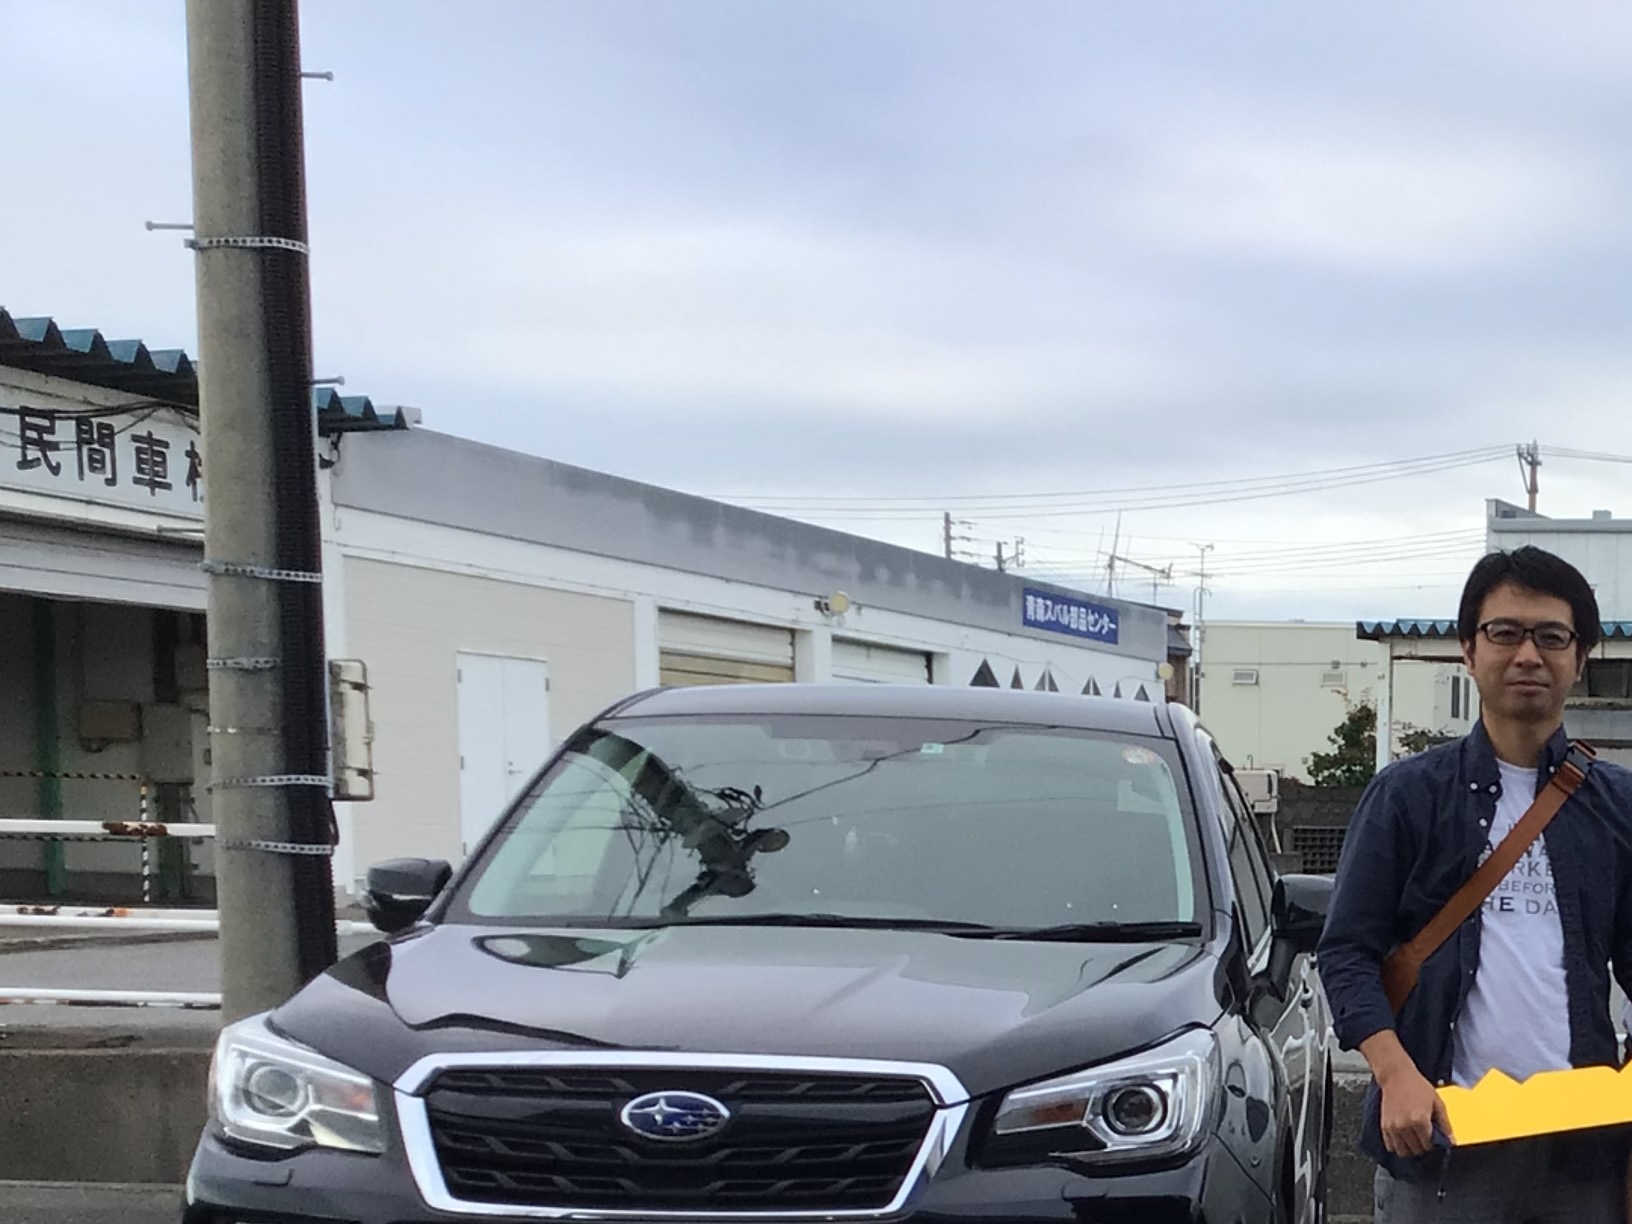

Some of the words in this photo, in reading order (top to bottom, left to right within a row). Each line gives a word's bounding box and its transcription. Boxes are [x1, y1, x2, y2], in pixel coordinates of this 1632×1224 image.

[1511, 861, 1553, 877] RKE
[1498, 879, 1555, 894] BEFOR
[1482, 896, 1515, 912] HE
[1525, 899, 1557, 915] DA
